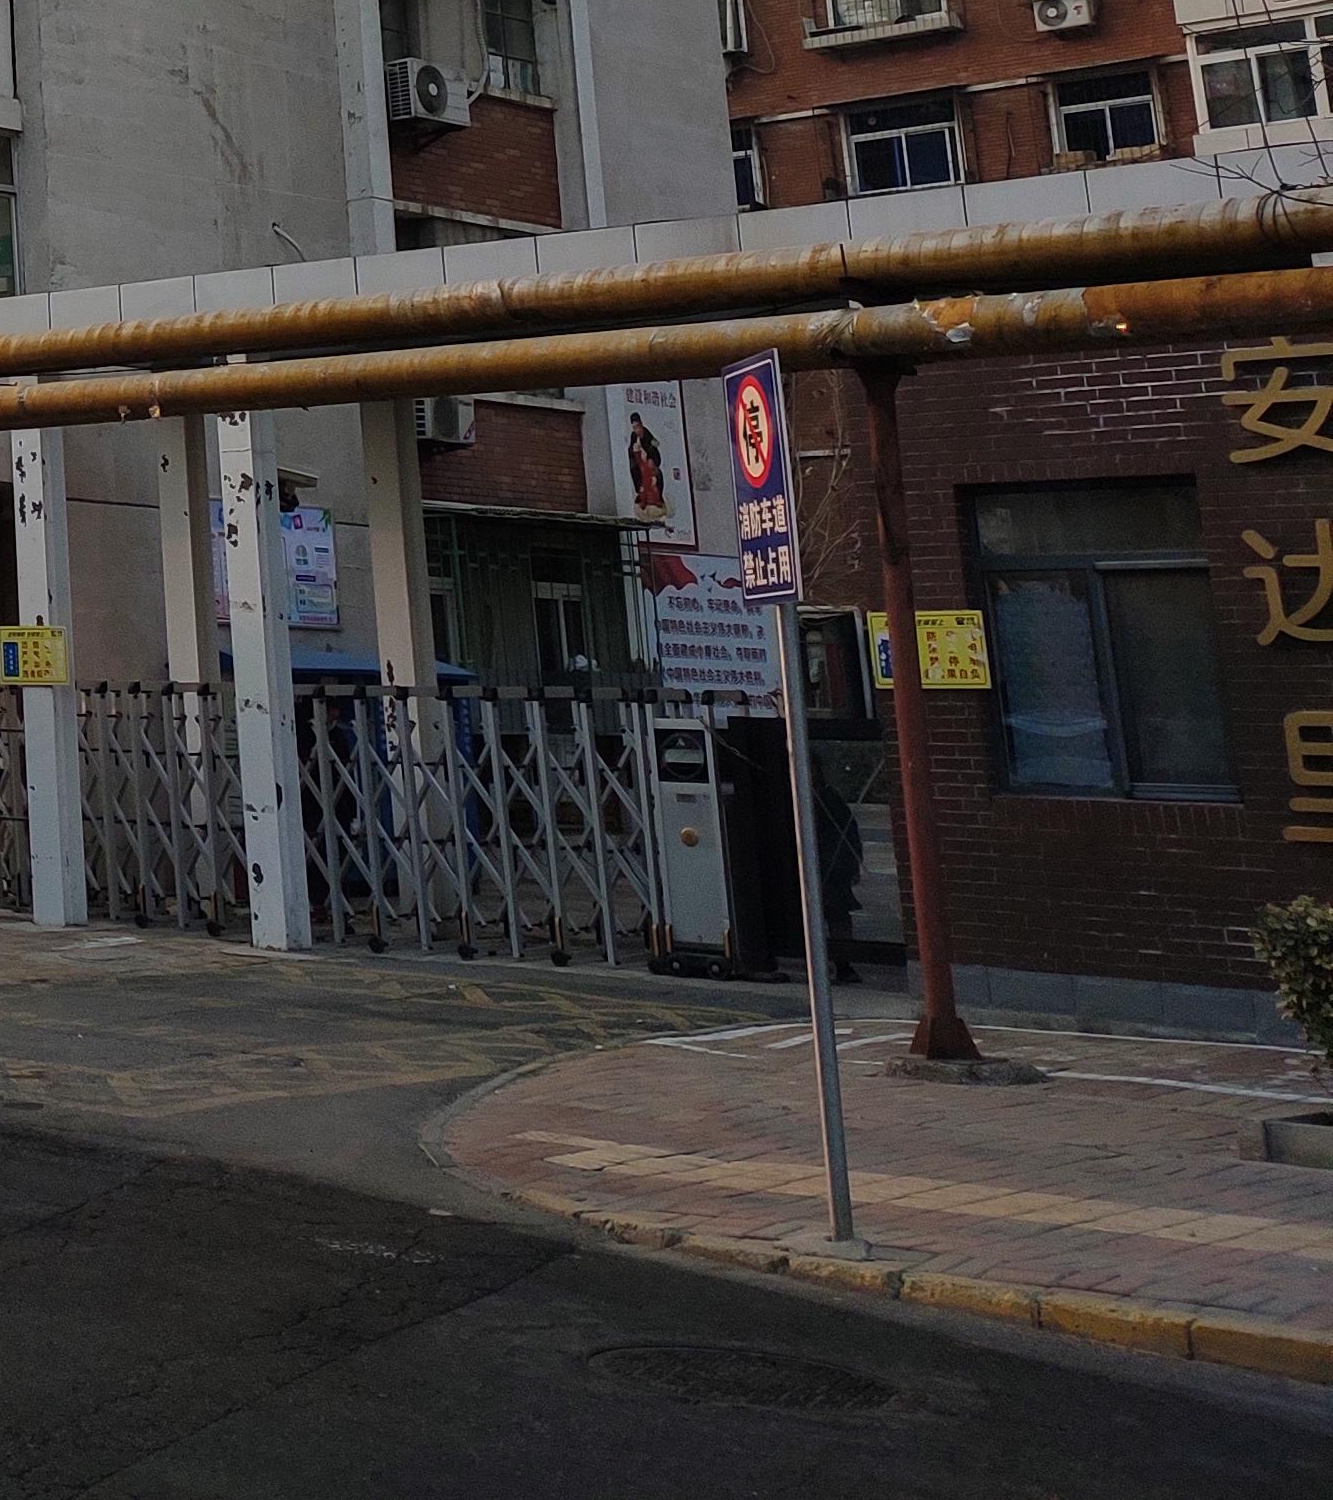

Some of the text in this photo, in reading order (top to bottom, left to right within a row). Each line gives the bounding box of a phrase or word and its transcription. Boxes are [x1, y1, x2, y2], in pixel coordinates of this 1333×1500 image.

[626, 388, 676, 409] 建设和谐社会
[739, 494, 788, 541] 消防车道
[743, 545, 792, 590] 禁止占用
